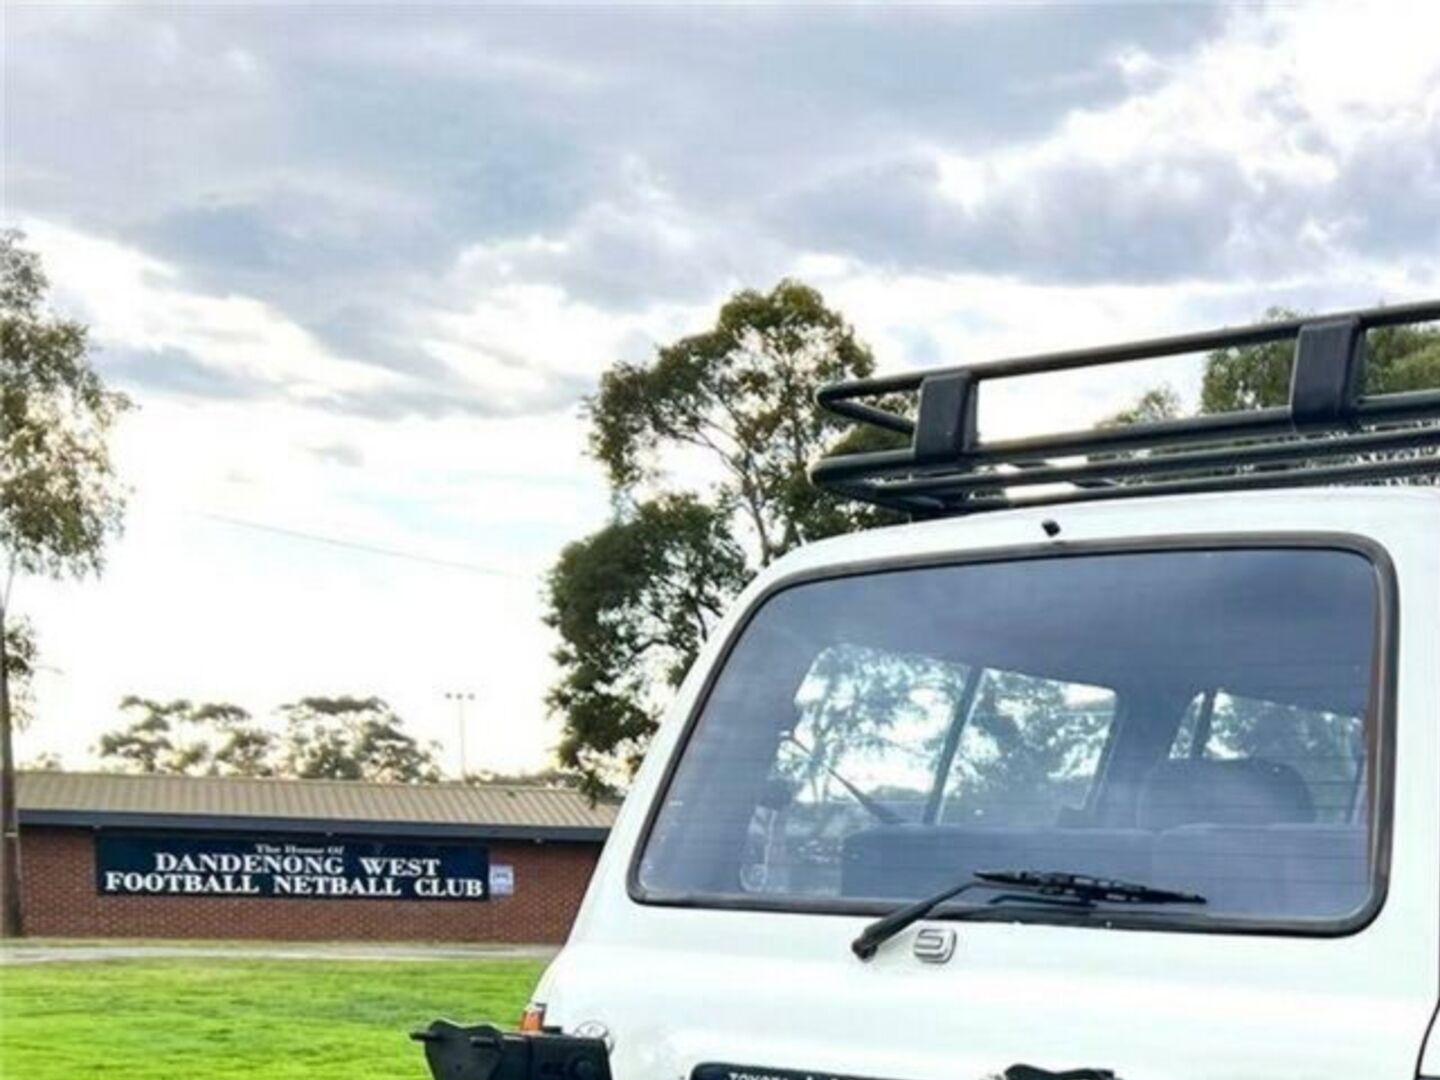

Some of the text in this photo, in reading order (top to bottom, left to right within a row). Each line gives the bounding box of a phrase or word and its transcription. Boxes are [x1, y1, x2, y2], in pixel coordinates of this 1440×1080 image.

[255, 843, 281, 854] The
[155, 852, 441, 877] DANDENONG WEST
[105, 871, 260, 894] FOOTBALL
[273, 874, 402, 896] NETBALL
[413, 878, 483, 897] CLUB
